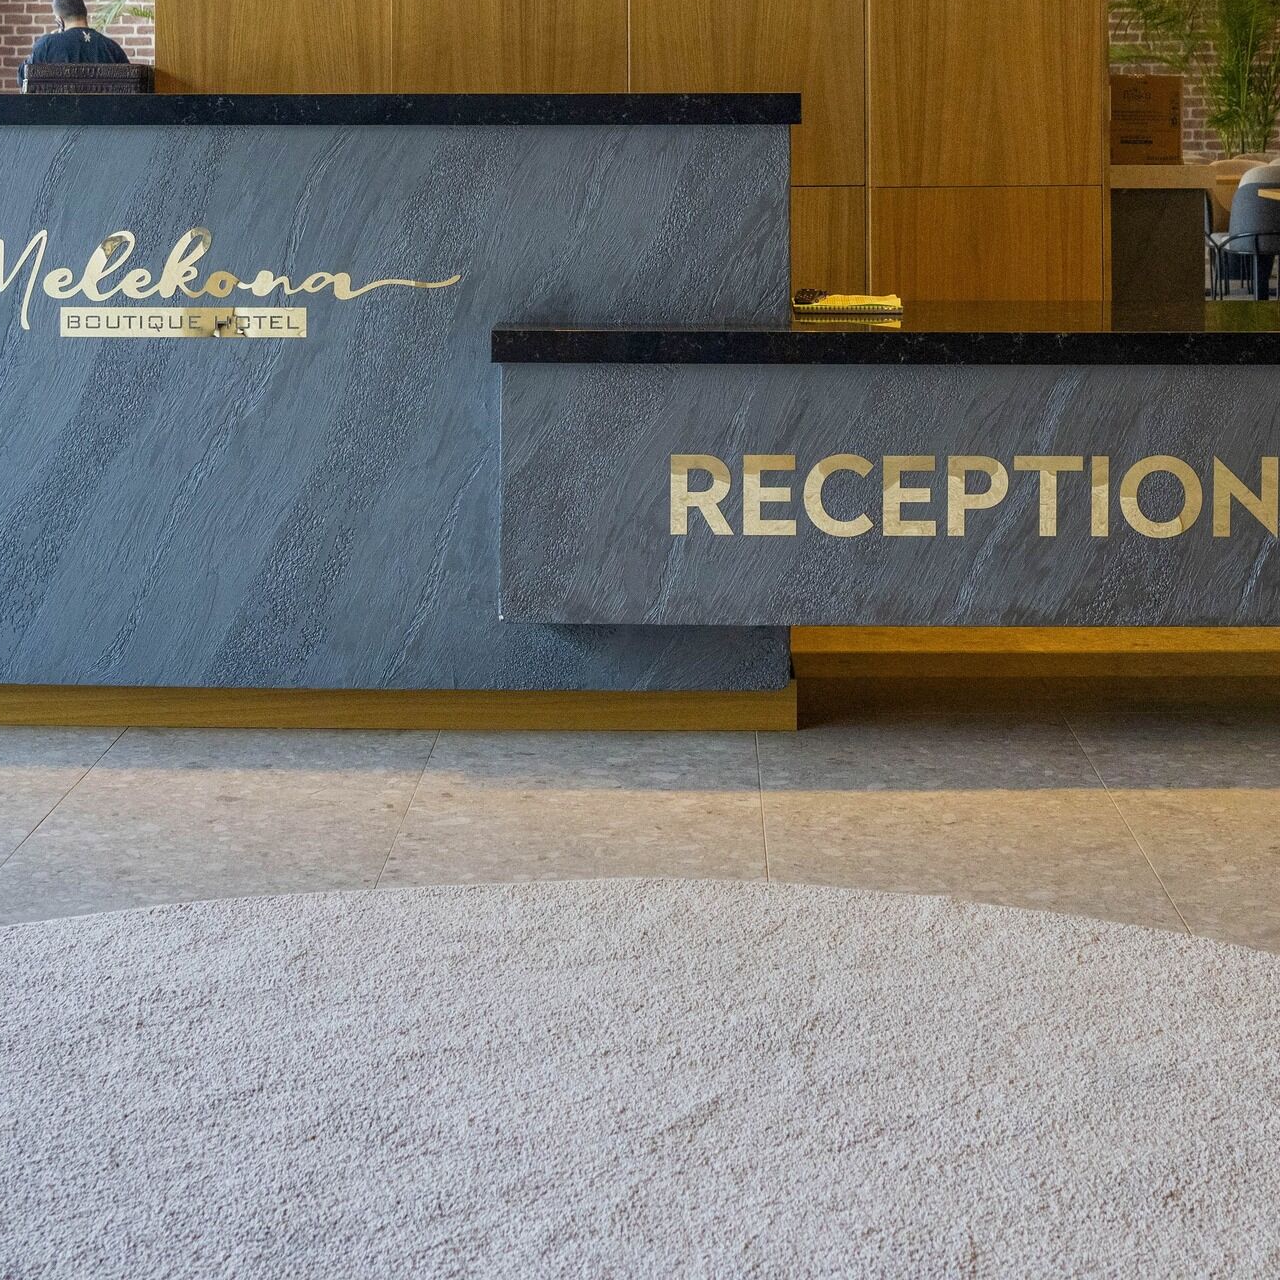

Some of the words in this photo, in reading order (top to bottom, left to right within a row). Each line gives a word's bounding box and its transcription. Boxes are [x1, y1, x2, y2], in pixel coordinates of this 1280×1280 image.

[66, 315, 202, 332] BOUTIQUE
[214, 315, 300, 330] HOTEL
[669, 453, 1279, 539] RECEPTION
